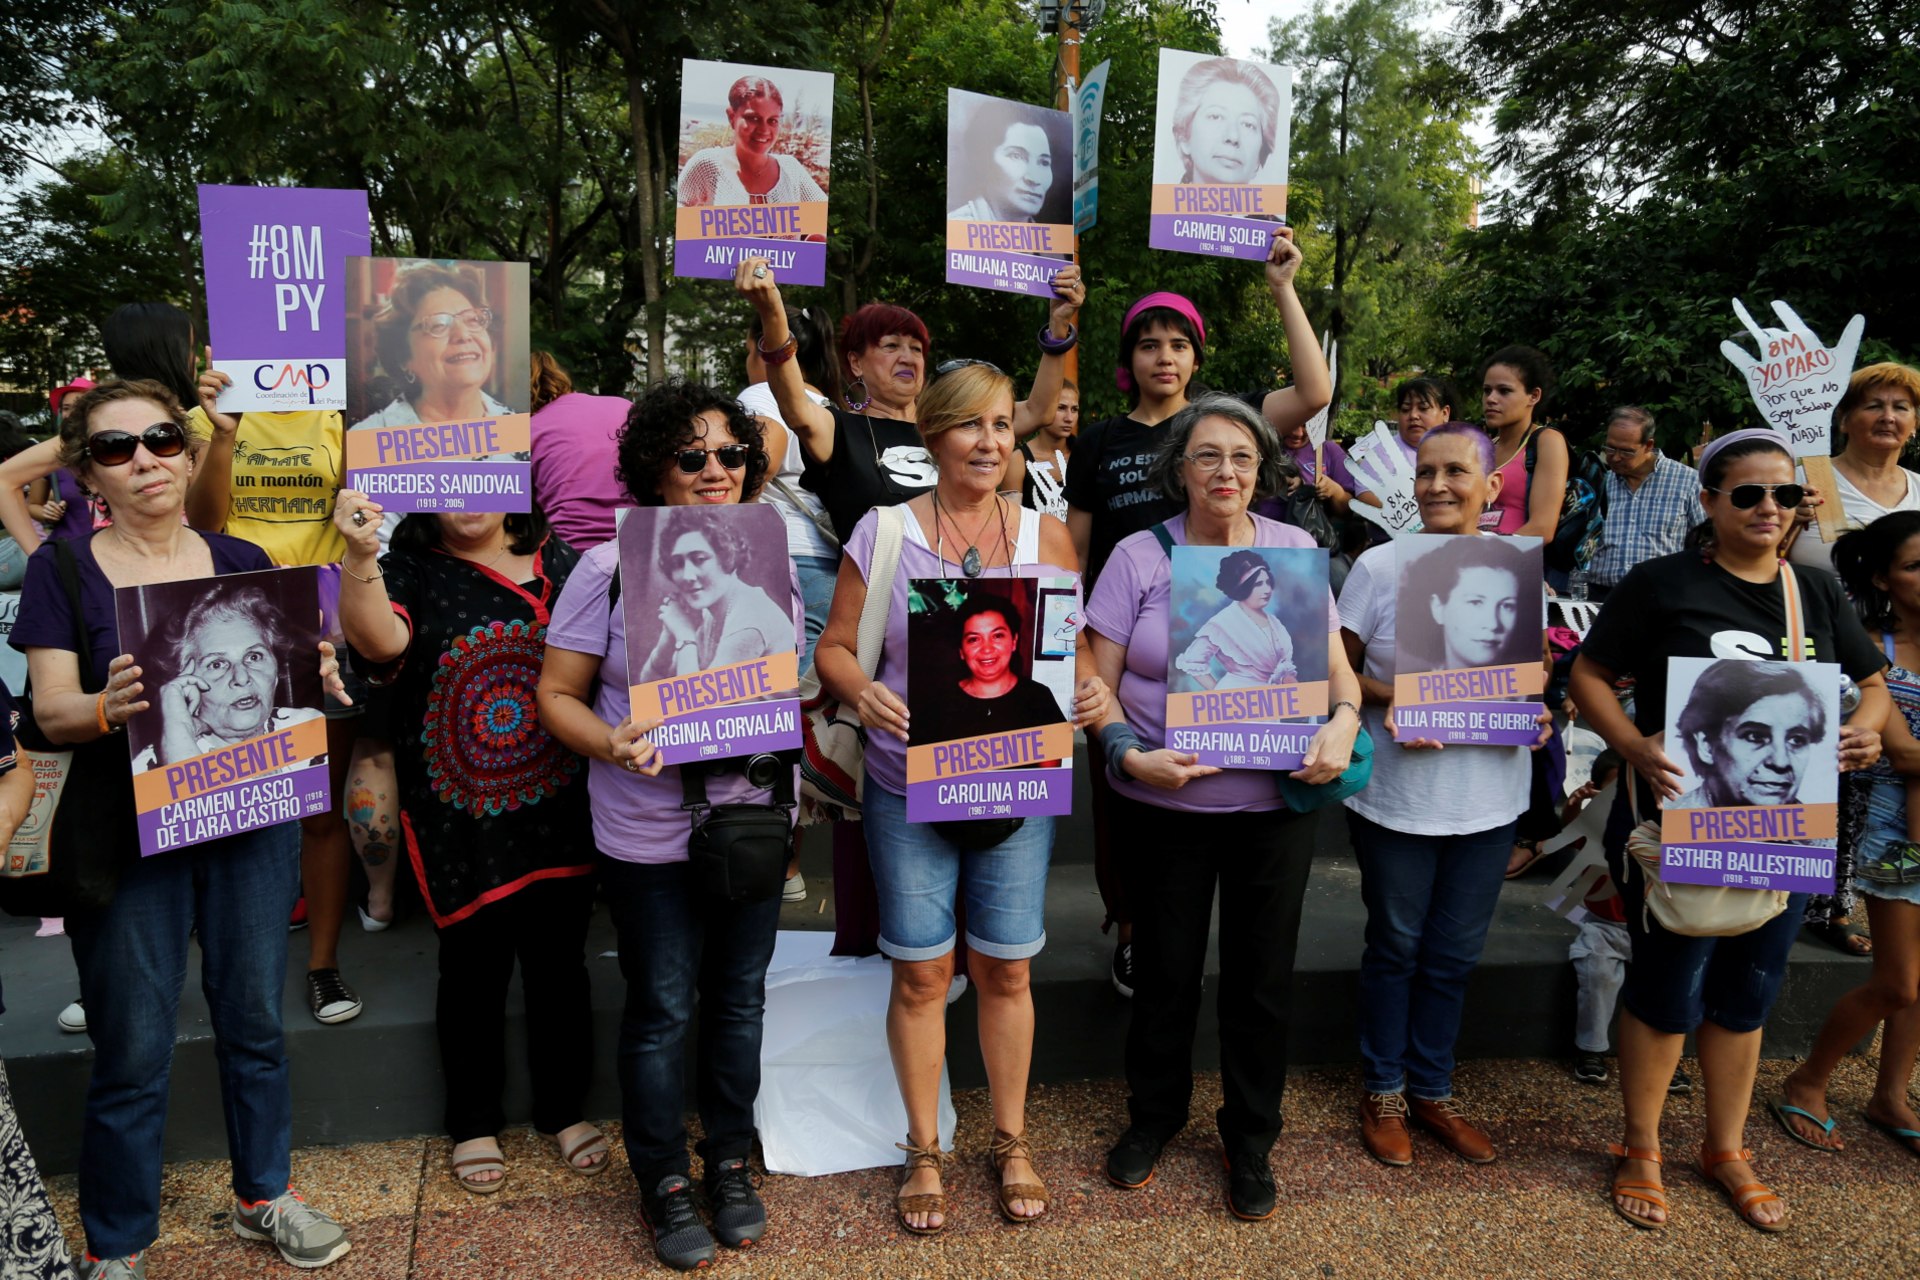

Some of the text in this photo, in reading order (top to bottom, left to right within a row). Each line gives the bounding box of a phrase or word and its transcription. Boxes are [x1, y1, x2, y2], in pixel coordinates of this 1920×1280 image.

[1174, 187, 1264, 213] PRESENTE
[700, 206, 801, 236] PRESENTE
[1173, 219, 1266, 247] CARMEN SOLER
[967, 223, 1052, 251] PRESENTE
[247, 224, 325, 280] #8M
[704, 245, 736, 265] ANY
[951, 252, 1008, 277] EMILIANA
[275, 283, 326, 331] PY
[1768, 333, 1806, 358] 8M
[1756, 349, 1830, 388] YO PARO
[1790, 388, 1816, 405] que
[1784, 421, 1801, 430] de
[376, 420, 500, 463] PRESENTE
[1109, 456, 1132, 470] NO
[236, 474, 323, 487] un montón
[354, 473, 523, 494] MERCEDES SANDOVAL
[235, 497, 327, 514] HERMANA
[416, 498, 437, 510] (1919
[444, 498, 465, 510] 2005)
[1390, 509, 1403, 524] YO
[657, 661, 772, 716] PRESENTE
[1418, 668, 1517, 702] PRESENTE
[1192, 687, 1300, 723] PRESENTE
[643, 707, 795, 748] VIRGINIA CORVALÁN
[1398, 710, 1540, 731] LILIA FREIS DE GUERRA
[1173, 730, 1245, 752] SERAFINA
[1448, 731, 1466, 741] (1918
[699, 744, 718, 757] (1900
[933, 730, 1045, 776] PRESENTE
[1252, 756, 1271, 766] 1957)
[166, 730, 297, 800] PRESENTE
[160, 777, 294, 826] CARMEN CASCO
[305, 790, 323, 804] (1918
[938, 780, 1048, 805] CAROLINA ROA
[306, 802, 324, 813] 1993)
[156, 796, 300, 849] DE LARA CASTRO
[1690, 808, 1806, 840] PRESENTE
[1665, 847, 1833, 879] ESTHER BALLESTRINO
[1723, 873, 1743, 884] (1918
[1749, 876, 1770, 887] 1977)
